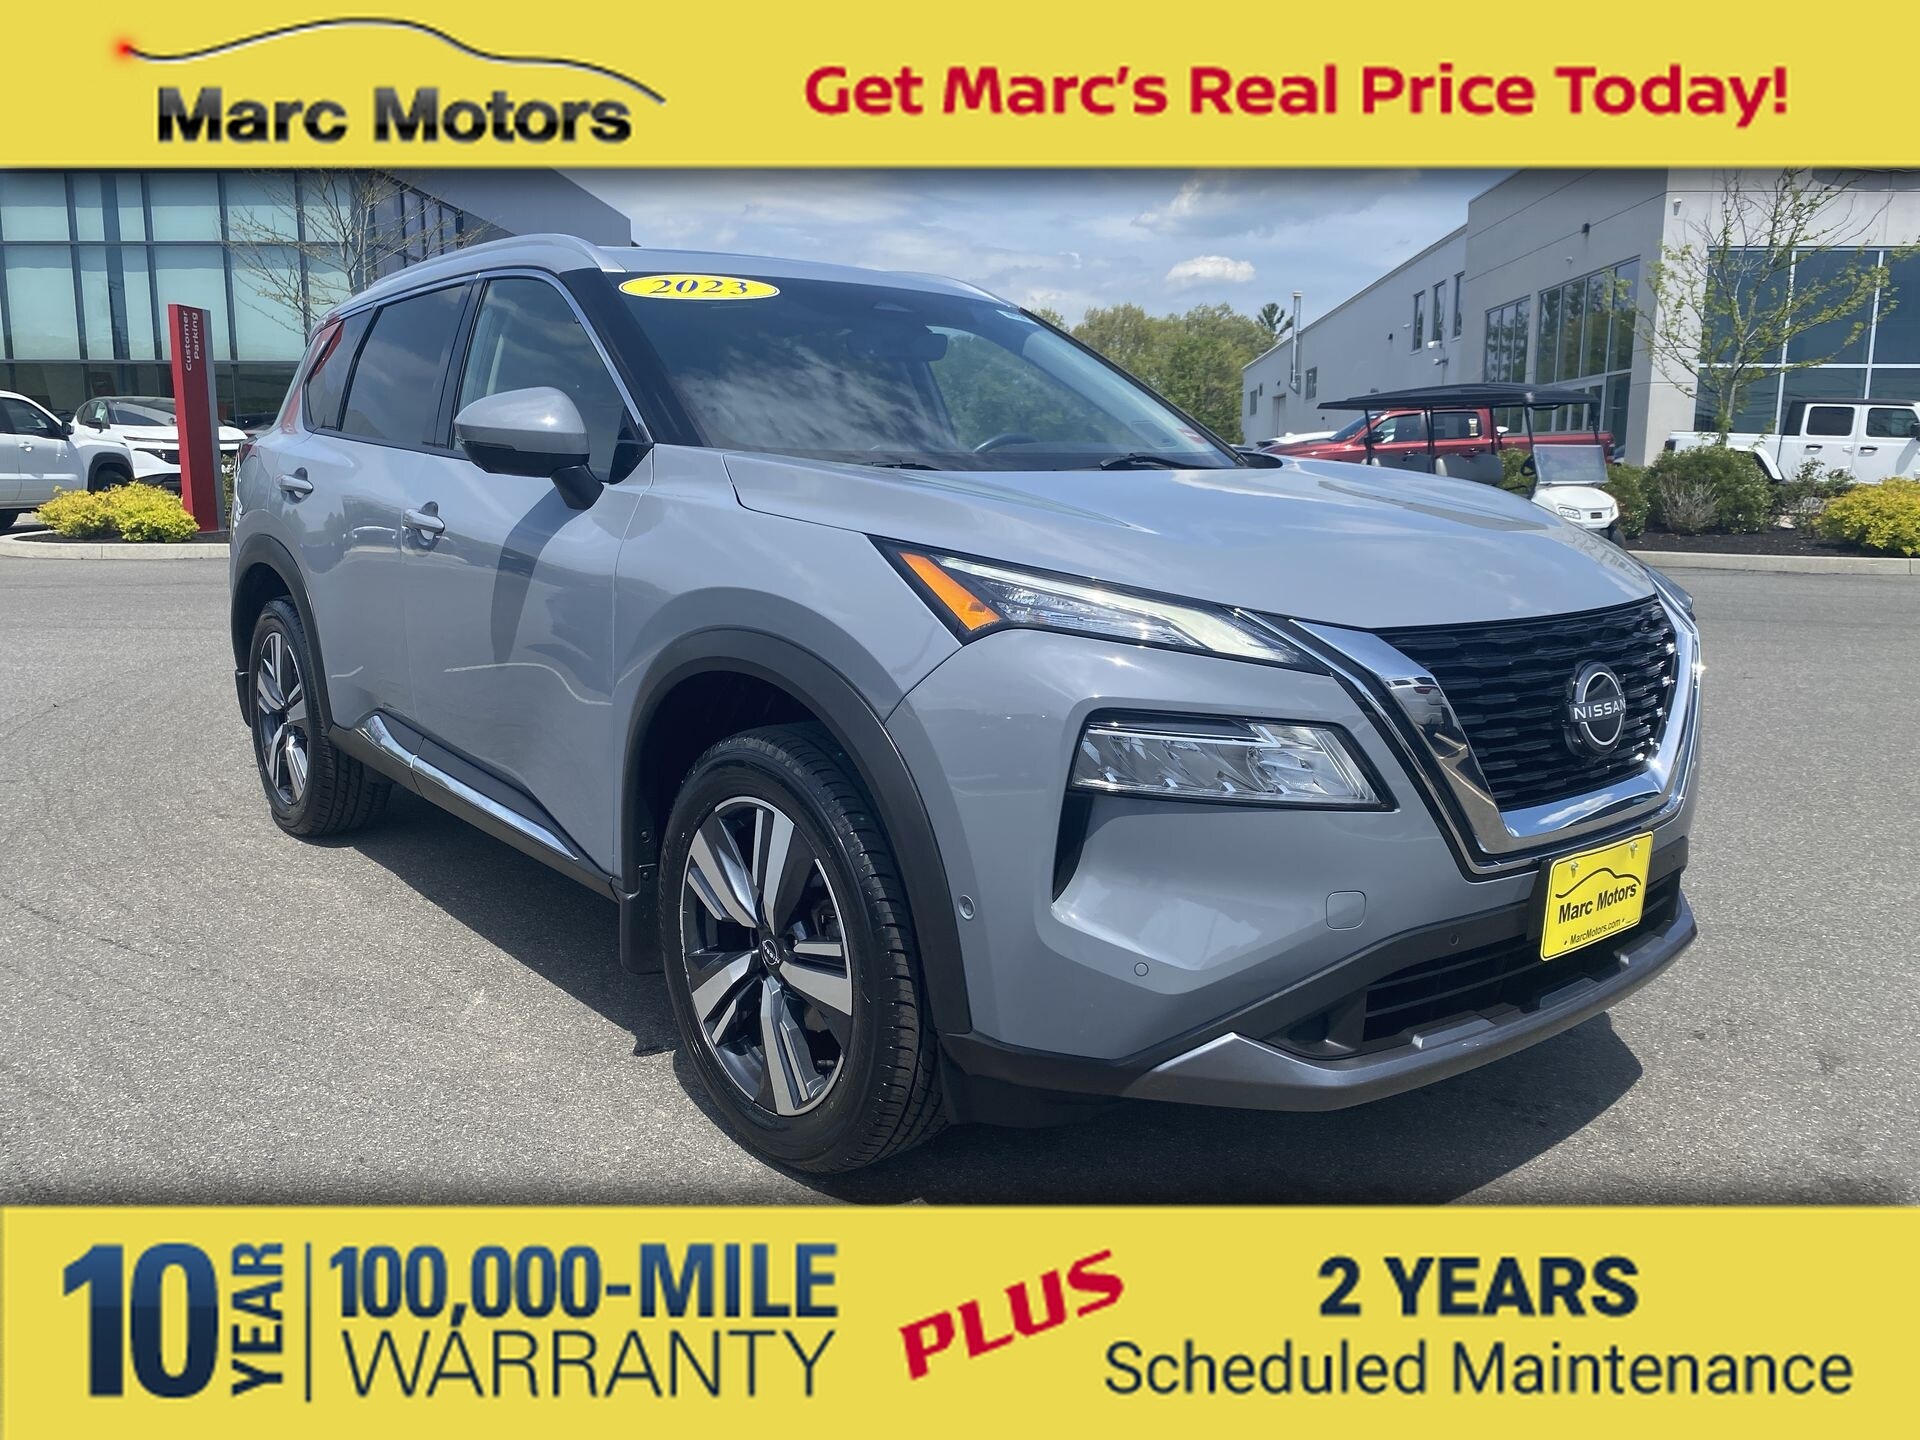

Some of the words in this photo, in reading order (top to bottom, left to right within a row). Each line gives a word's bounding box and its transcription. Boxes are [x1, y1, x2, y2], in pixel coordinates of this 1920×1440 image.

[648, 279, 748, 295] 2023
[183, 310, 192, 371] Customer
[191, 312, 200, 360] Parking
[1573, 698, 1626, 720] NISSAN
[1558, 899, 1593, 924] Marc
[1596, 883, 1637, 912] Motors
[1569, 917, 1622, 945] MarcMotors.com
